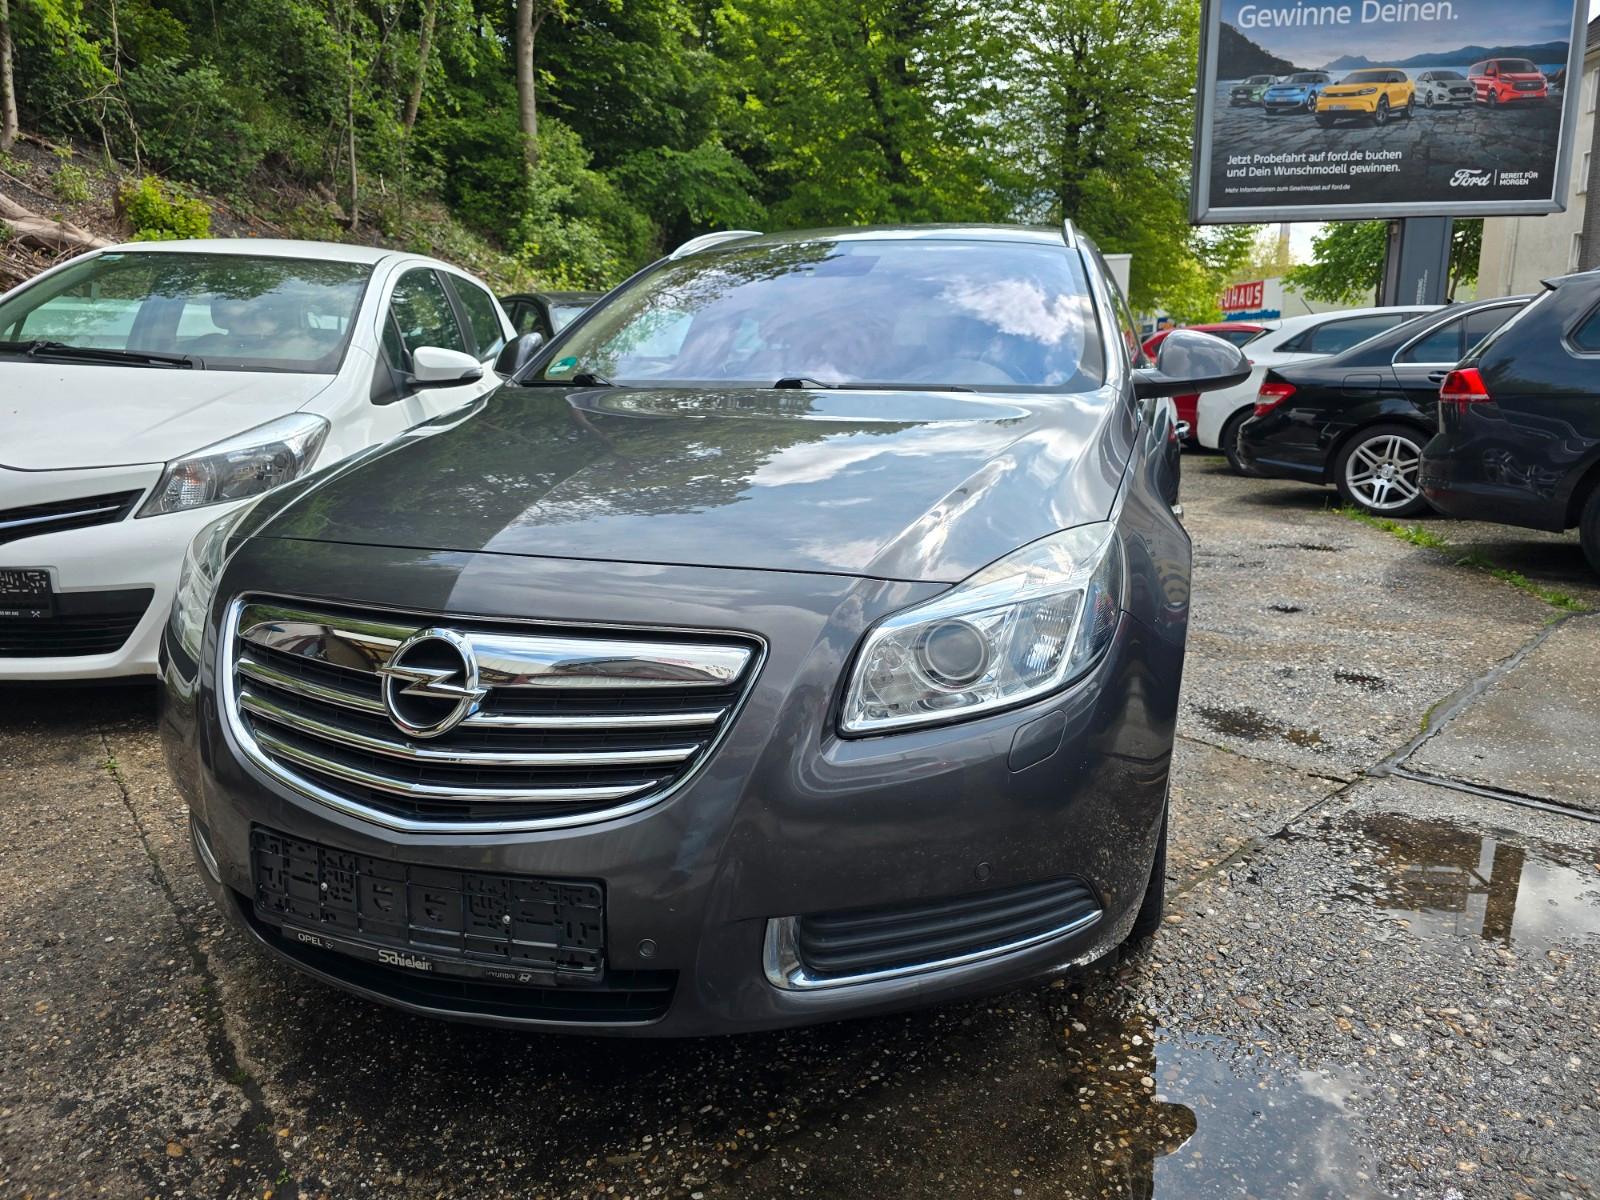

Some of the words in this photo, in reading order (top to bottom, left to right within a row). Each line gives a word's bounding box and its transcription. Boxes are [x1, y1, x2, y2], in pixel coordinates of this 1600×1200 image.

[1237, 1, 1352, 28] Gewinne
[1360, 0, 1459, 23] Deinen.
[1226, 154, 1251, 165] Jetzt
[1253, 152, 1306, 164] Probefahrt
[1308, 151, 1326, 162] auf
[1327, 150, 1363, 161] ford.de
[1365, 149, 1402, 160] buchen
[1226, 167, 1246, 177] und
[1248, 166, 1271, 177] Dein
[1273, 163, 1347, 176] Wunschmodell
[1349, 162, 1401, 175] gewinnen.
[1449, 168, 1492, 187] Ford
[1500, 172, 1524, 180] BEREIT
[1217, 285, 1262, 308] UHAUS
[297, 933, 323, 946] OPEL
